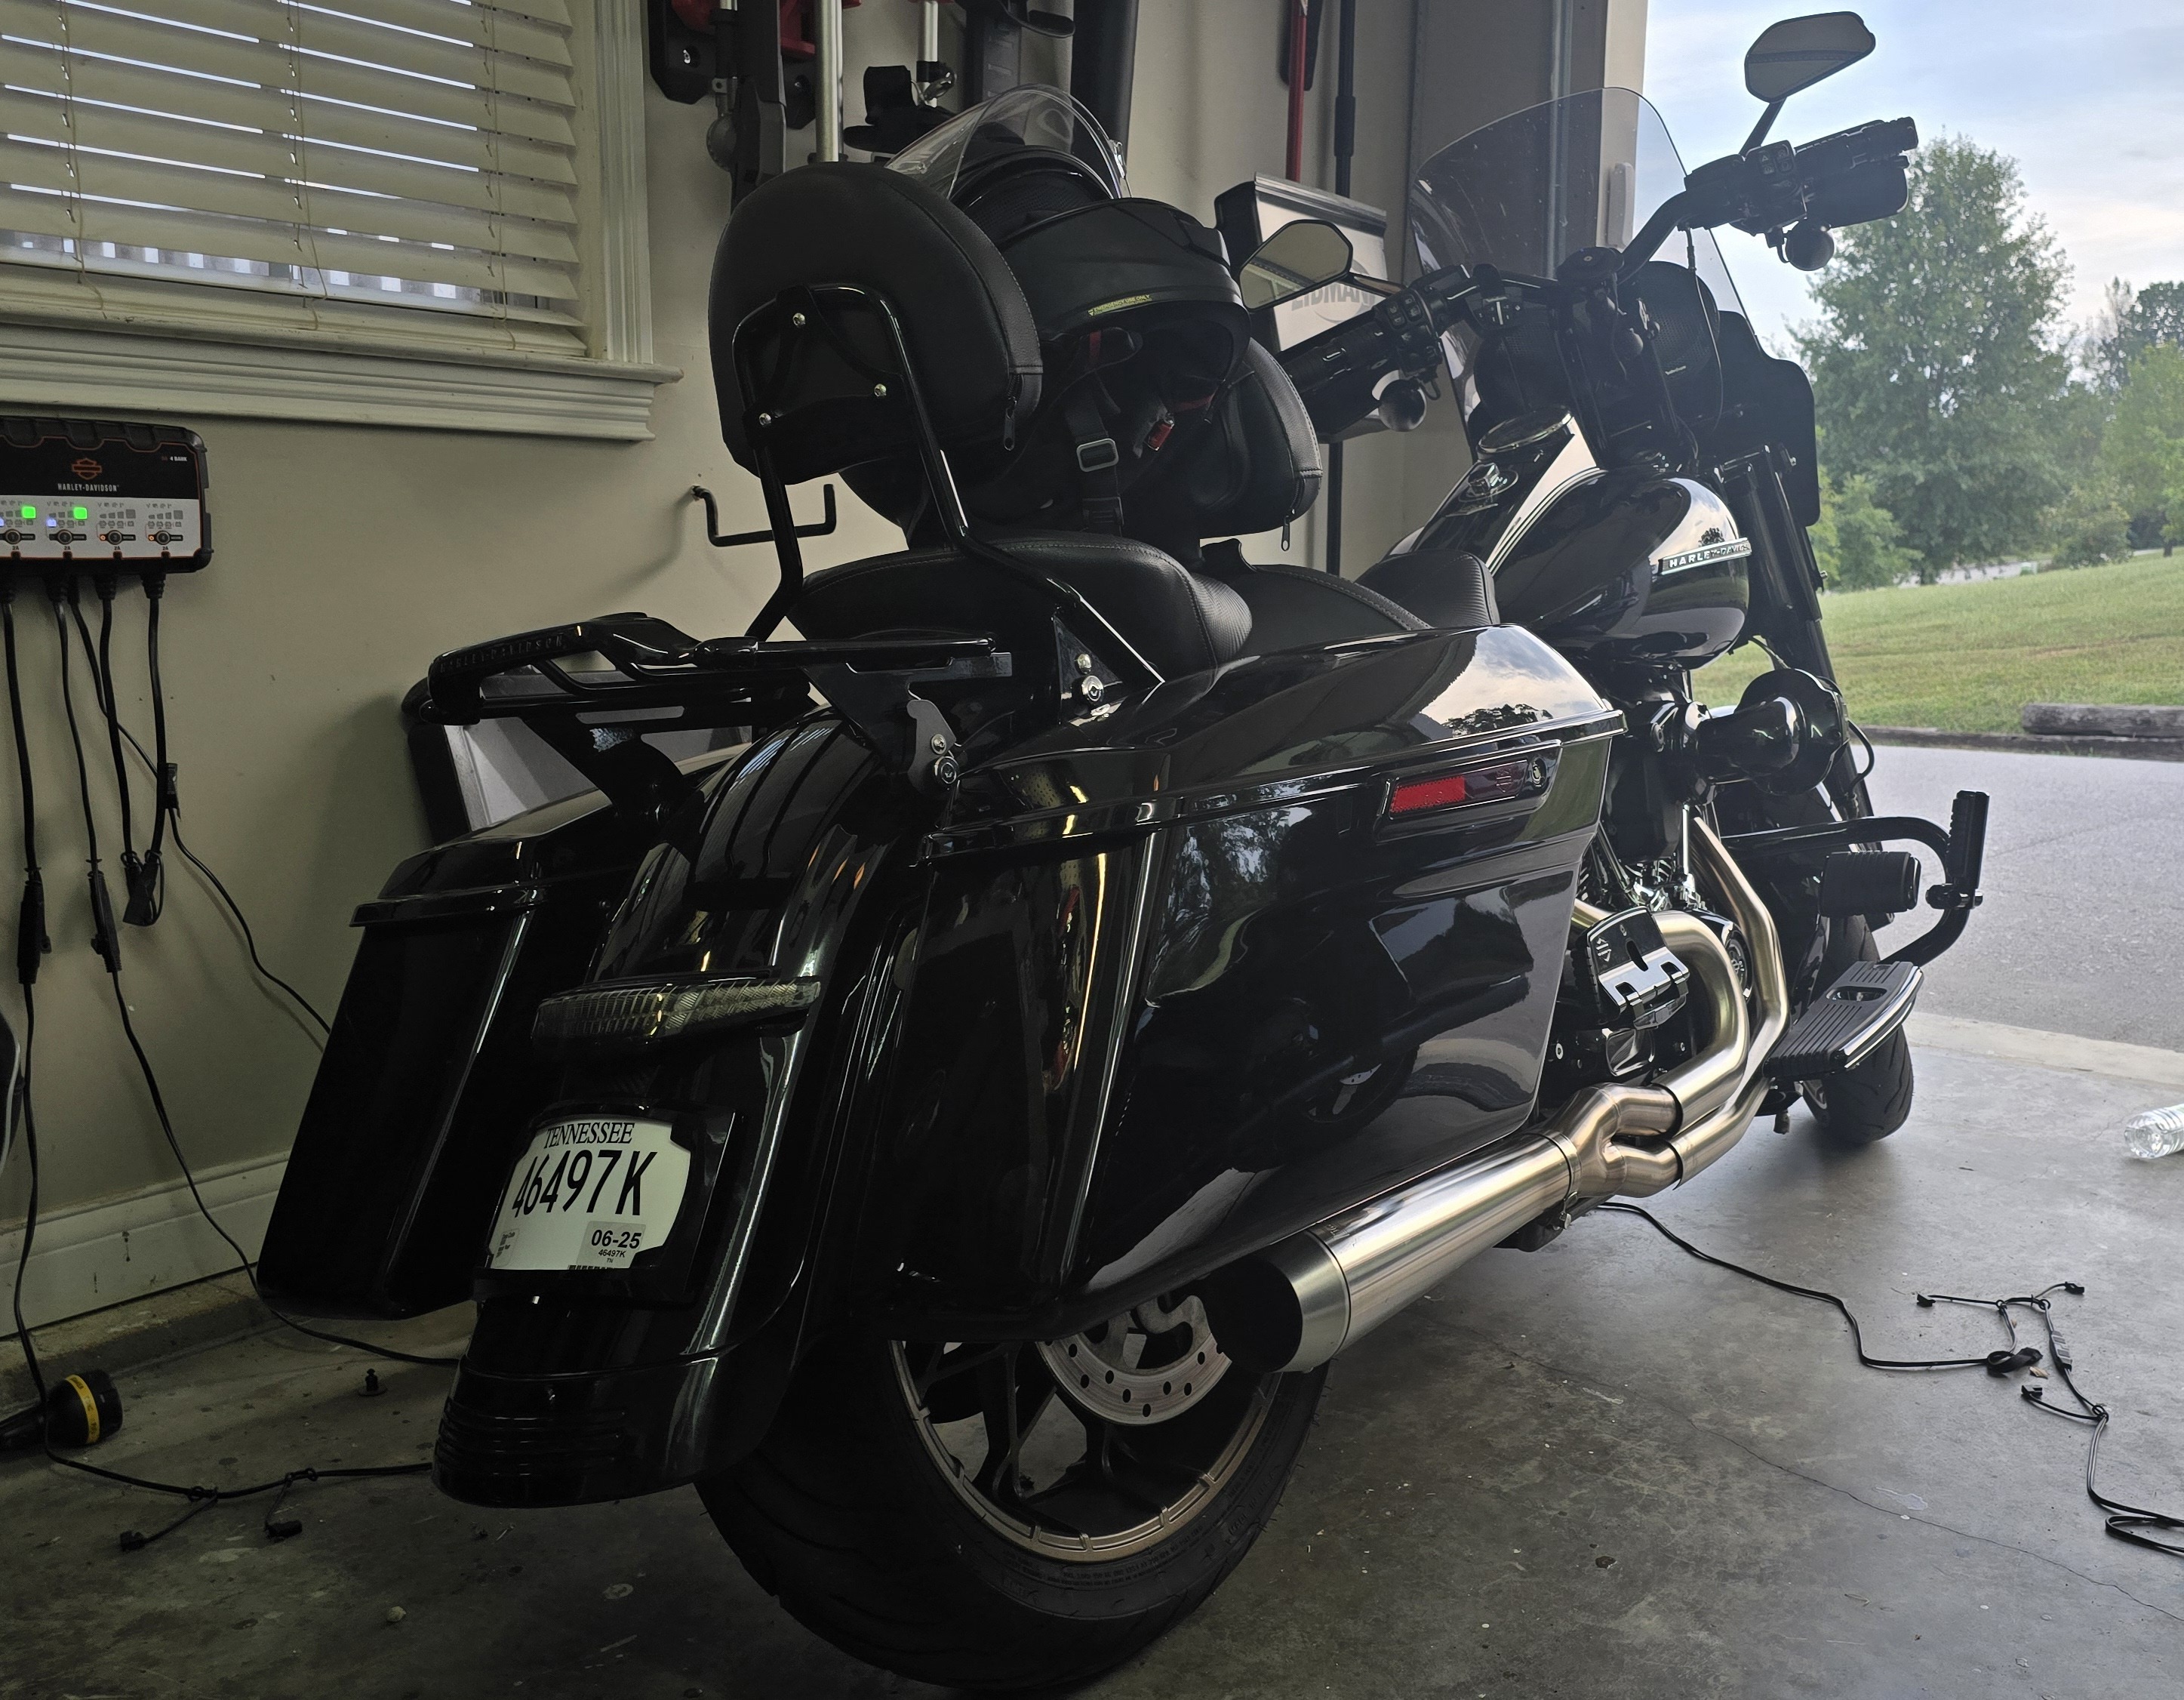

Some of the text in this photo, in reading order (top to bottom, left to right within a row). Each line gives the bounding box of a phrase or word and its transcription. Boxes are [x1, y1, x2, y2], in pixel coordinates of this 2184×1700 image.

[1094, 299, 1124, 312] EMERGENCY
[58, 483, 118, 492] HARLEY-DAVIDSON
[543, 1122, 635, 1148] TENNESSEE
[512, 1150, 657, 1218] 46497K
[591, 1229, 642, 1249] 06-25
[598, 1249, 626, 1258] 46497K
